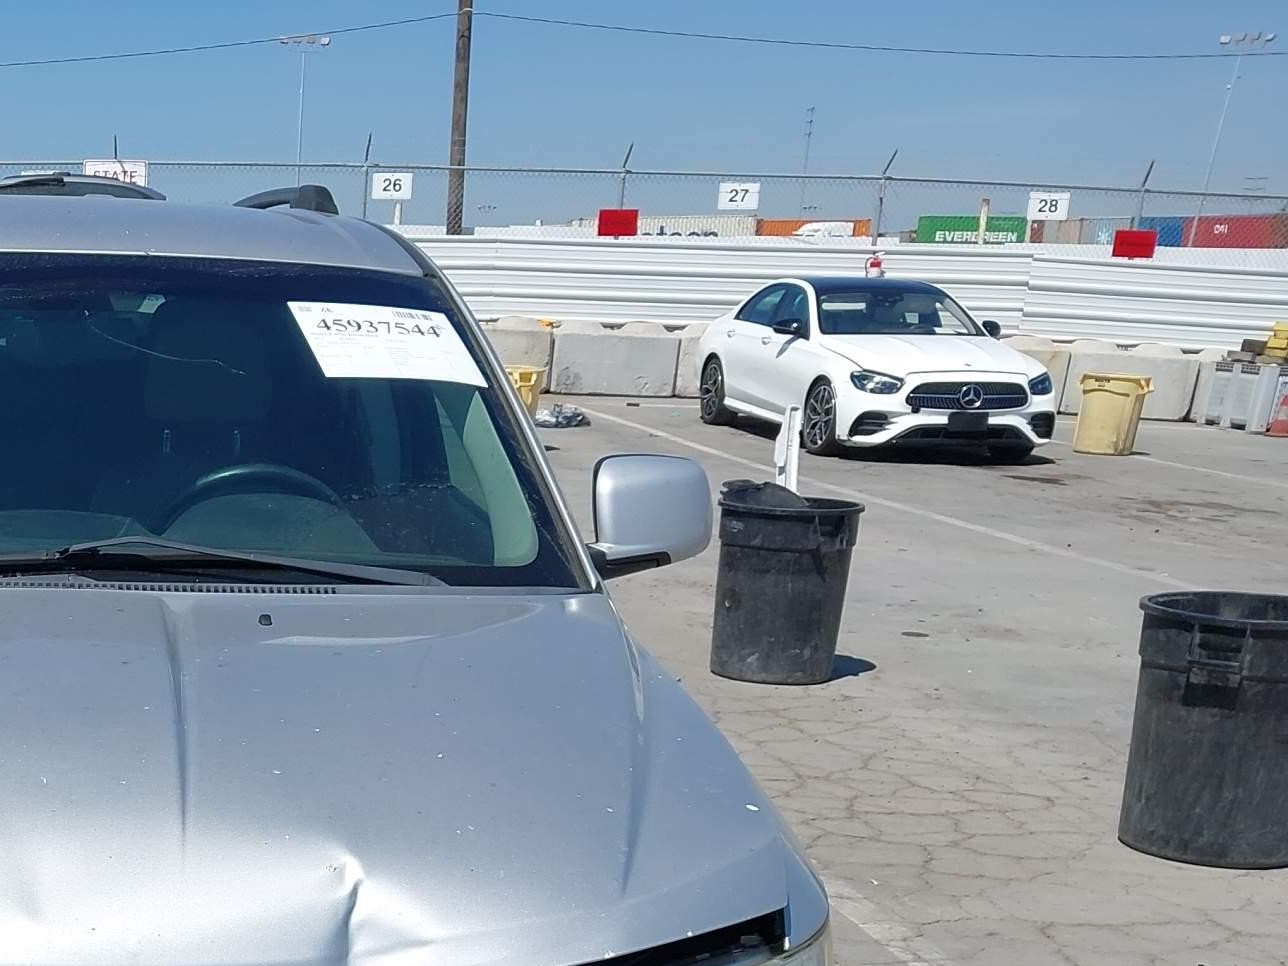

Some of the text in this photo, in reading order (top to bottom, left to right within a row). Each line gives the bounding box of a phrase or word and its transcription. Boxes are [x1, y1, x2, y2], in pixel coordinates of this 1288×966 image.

[383, 178, 402, 192] 26
[729, 189, 749, 203] 27
[1038, 199, 1058, 213] 28
[935, 230, 1018, 242] EVERGREEN
[317, 318, 441, 338] 45937544
